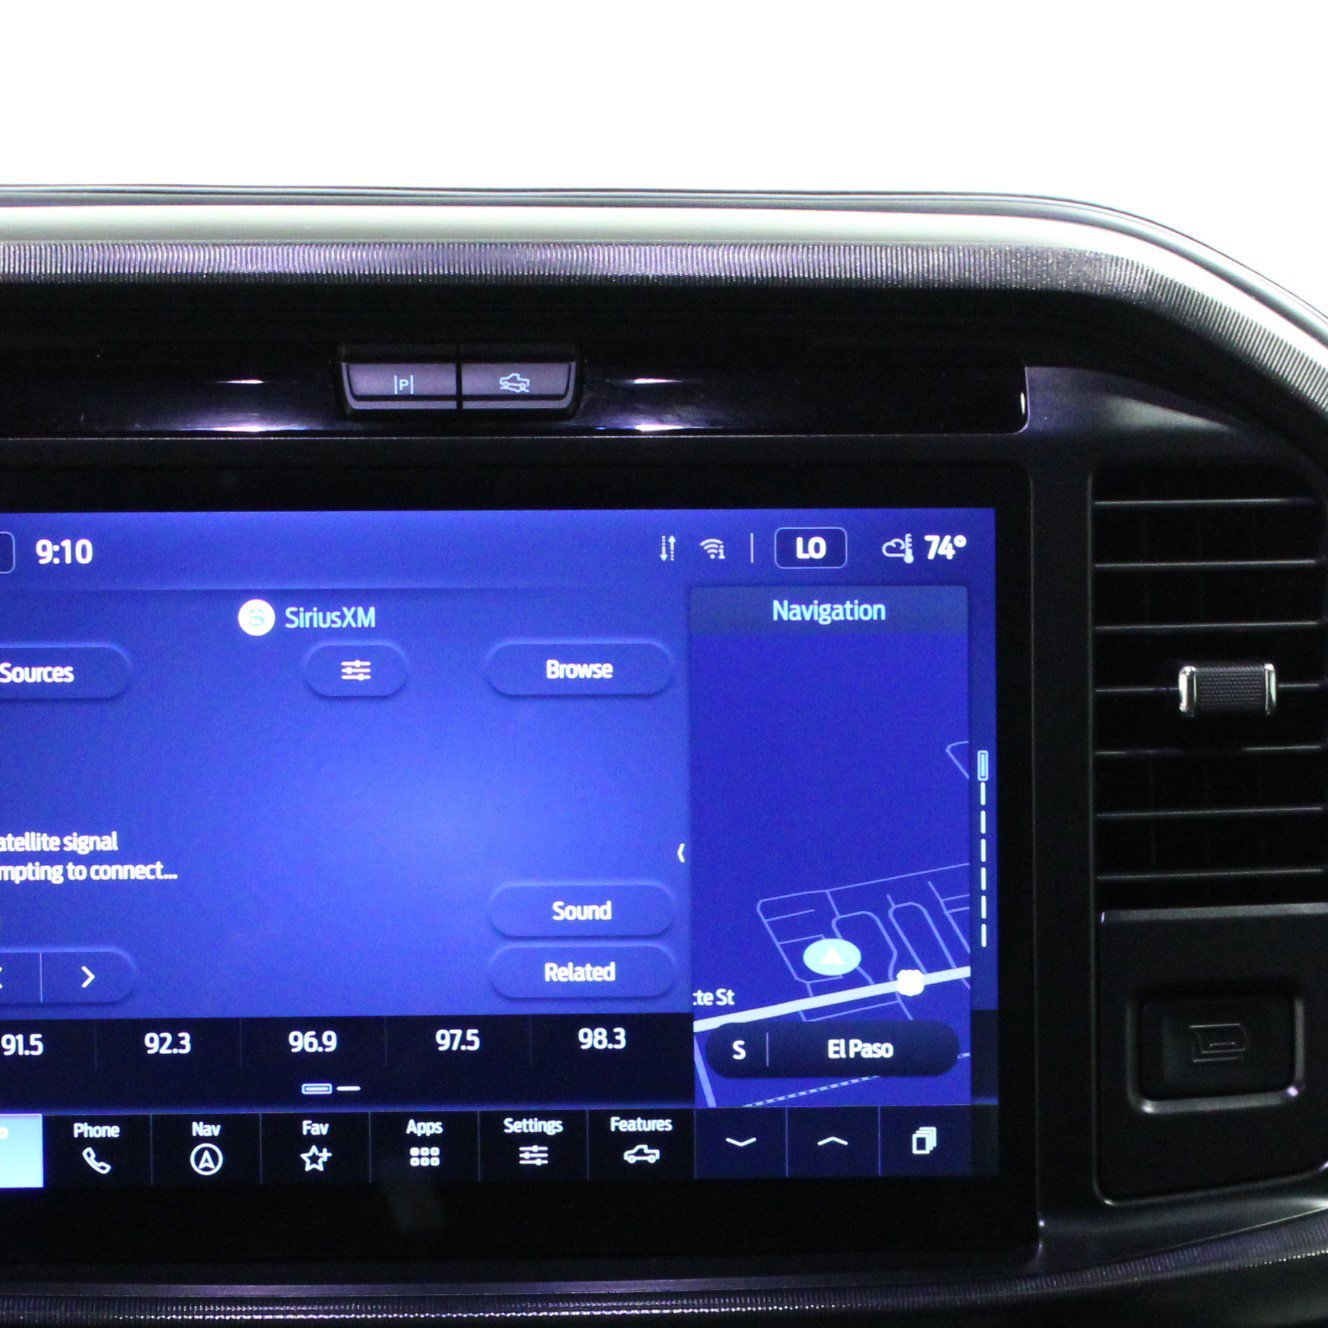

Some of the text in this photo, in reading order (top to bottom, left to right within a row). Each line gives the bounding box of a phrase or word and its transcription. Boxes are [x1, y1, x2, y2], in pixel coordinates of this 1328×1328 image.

[36, 539, 93, 565] 9:10
[795, 537, 826, 559] LO
[285, 606, 376, 629] SiriusXM
[772, 600, 886, 625] Navigation
[545, 659, 613, 679] Browse
[63, 832, 118, 854] signal
[67, 862, 87, 881] to
[90, 862, 178, 880] connect...
[552, 900, 612, 921] Sound
[544, 962, 616, 983] Related
[716, 988, 735, 1006] St
[1, 1033, 44, 1056] 91.5
[144, 1032, 191, 1054] 92.3
[289, 1030, 337, 1053] 96.9
[436, 1029, 480, 1051] 97.5
[578, 1027, 627, 1050] 98.3
[732, 1040, 746, 1060] S
[828, 1039, 894, 1060] El Paso
[74, 1122, 119, 1138] Phone
[192, 1122, 221, 1137] Nav
[302, 1120, 329, 1135] Fav
[406, 1119, 443, 1138] Apps
[504, 1117, 563, 1134] Settings
[610, 1116, 672, 1132] Features
